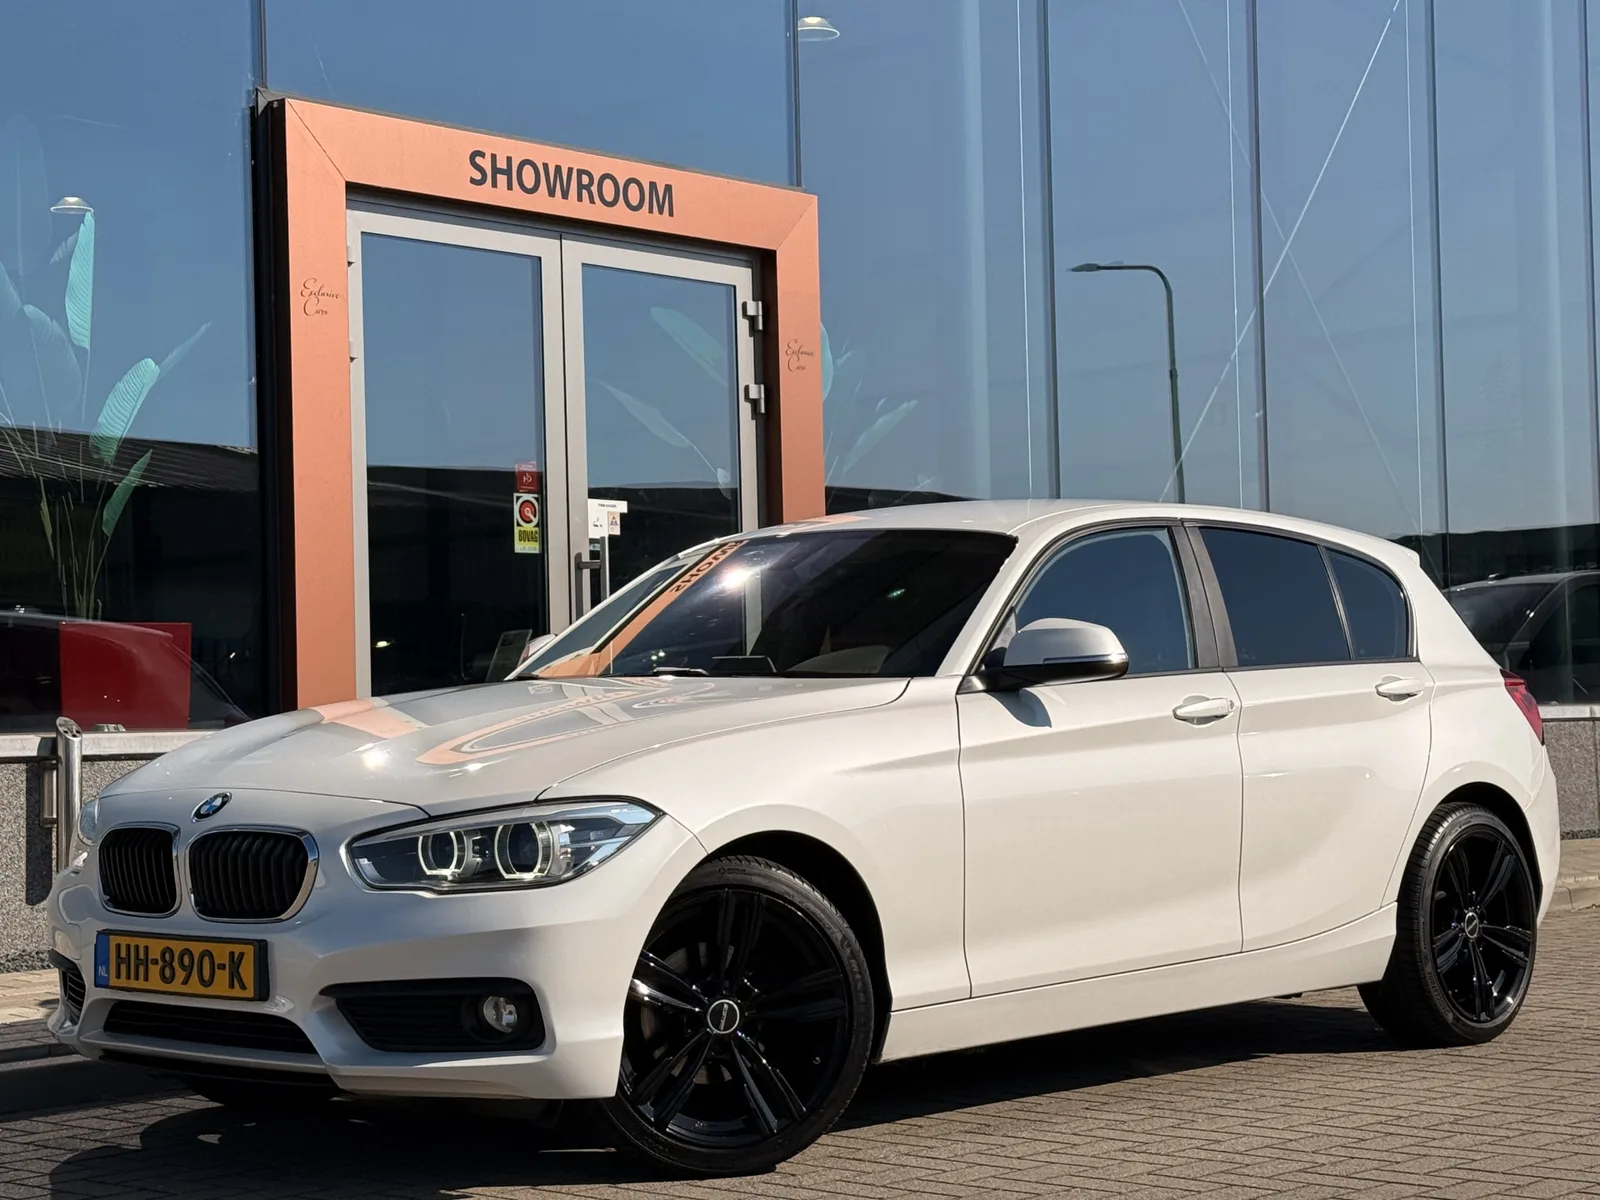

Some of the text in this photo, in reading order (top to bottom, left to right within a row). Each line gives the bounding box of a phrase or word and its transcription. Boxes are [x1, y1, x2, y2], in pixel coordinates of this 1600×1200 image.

[469, 150, 674, 217] SHOWROOM
[518, 529, 539, 543] BOVAG
[98, 942, 248, 991] NL HH-890-K
